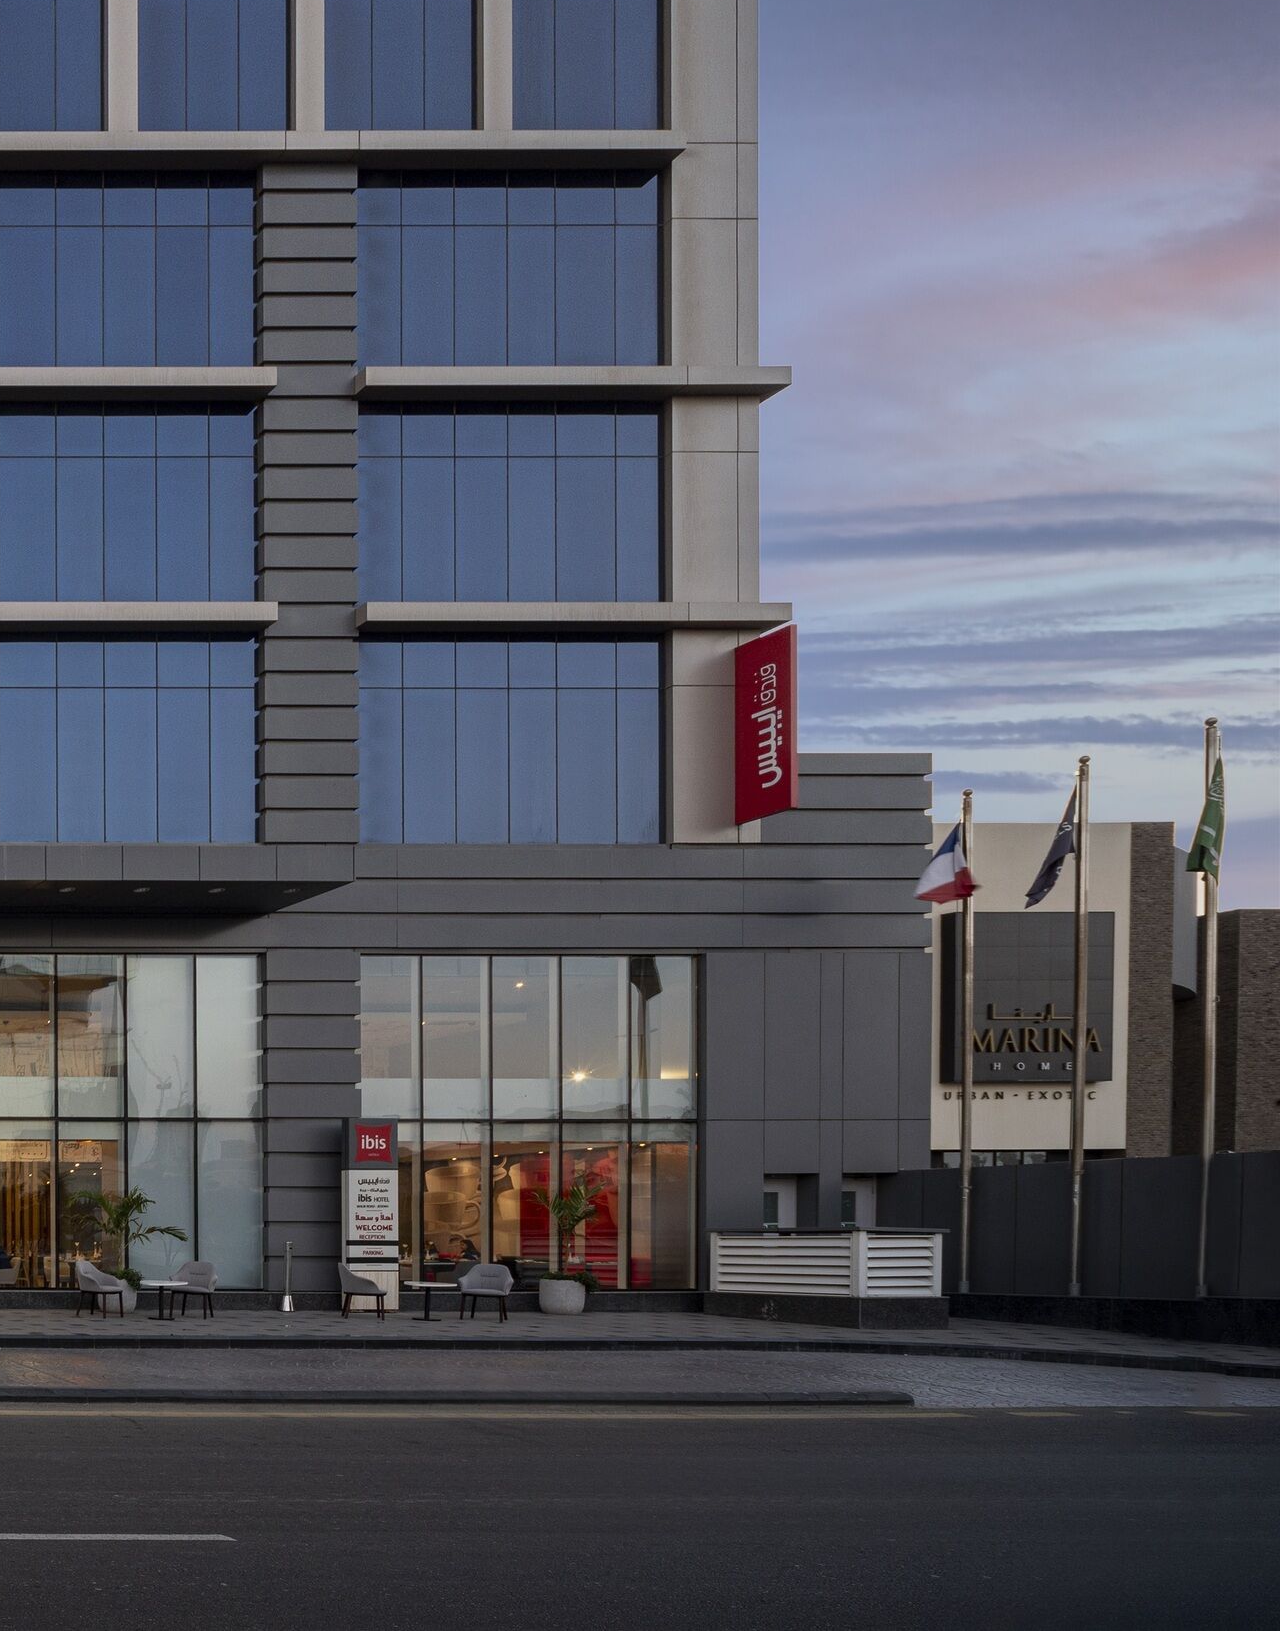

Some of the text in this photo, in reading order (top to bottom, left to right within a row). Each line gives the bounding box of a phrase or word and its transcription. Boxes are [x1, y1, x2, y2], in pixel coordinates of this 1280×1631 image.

[753, 663, 776, 706] فندق
[973, 1027, 1103, 1053] MARINA
[993, 1062, 1073, 1070] HOME
[1028, 1090, 1097, 1101] EXOTC
[361, 1134, 386, 1149] ibis
[357, 1194, 372, 1202] ibis
